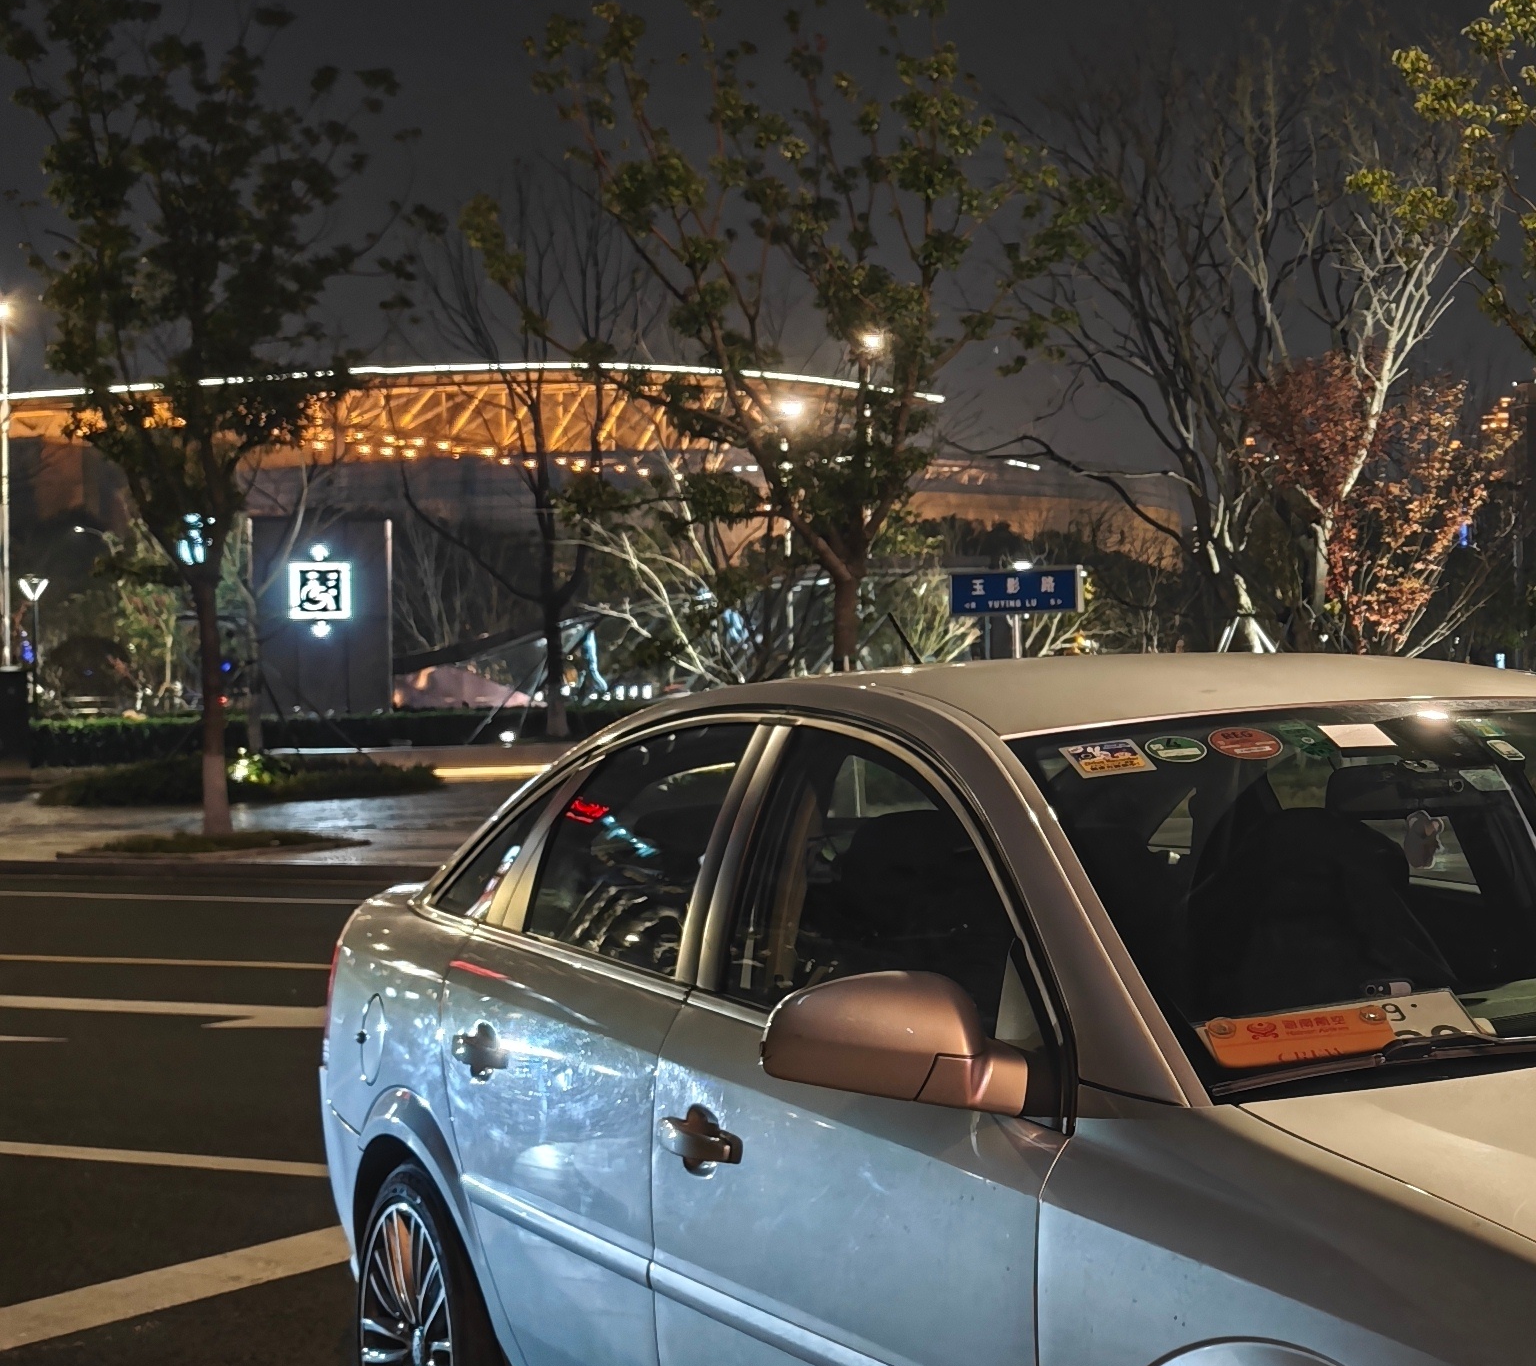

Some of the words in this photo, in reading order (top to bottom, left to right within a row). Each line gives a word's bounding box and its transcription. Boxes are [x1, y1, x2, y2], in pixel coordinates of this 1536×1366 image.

[971, 575, 1055, 596] 玉影路
[1025, 598, 1037, 608] LU
